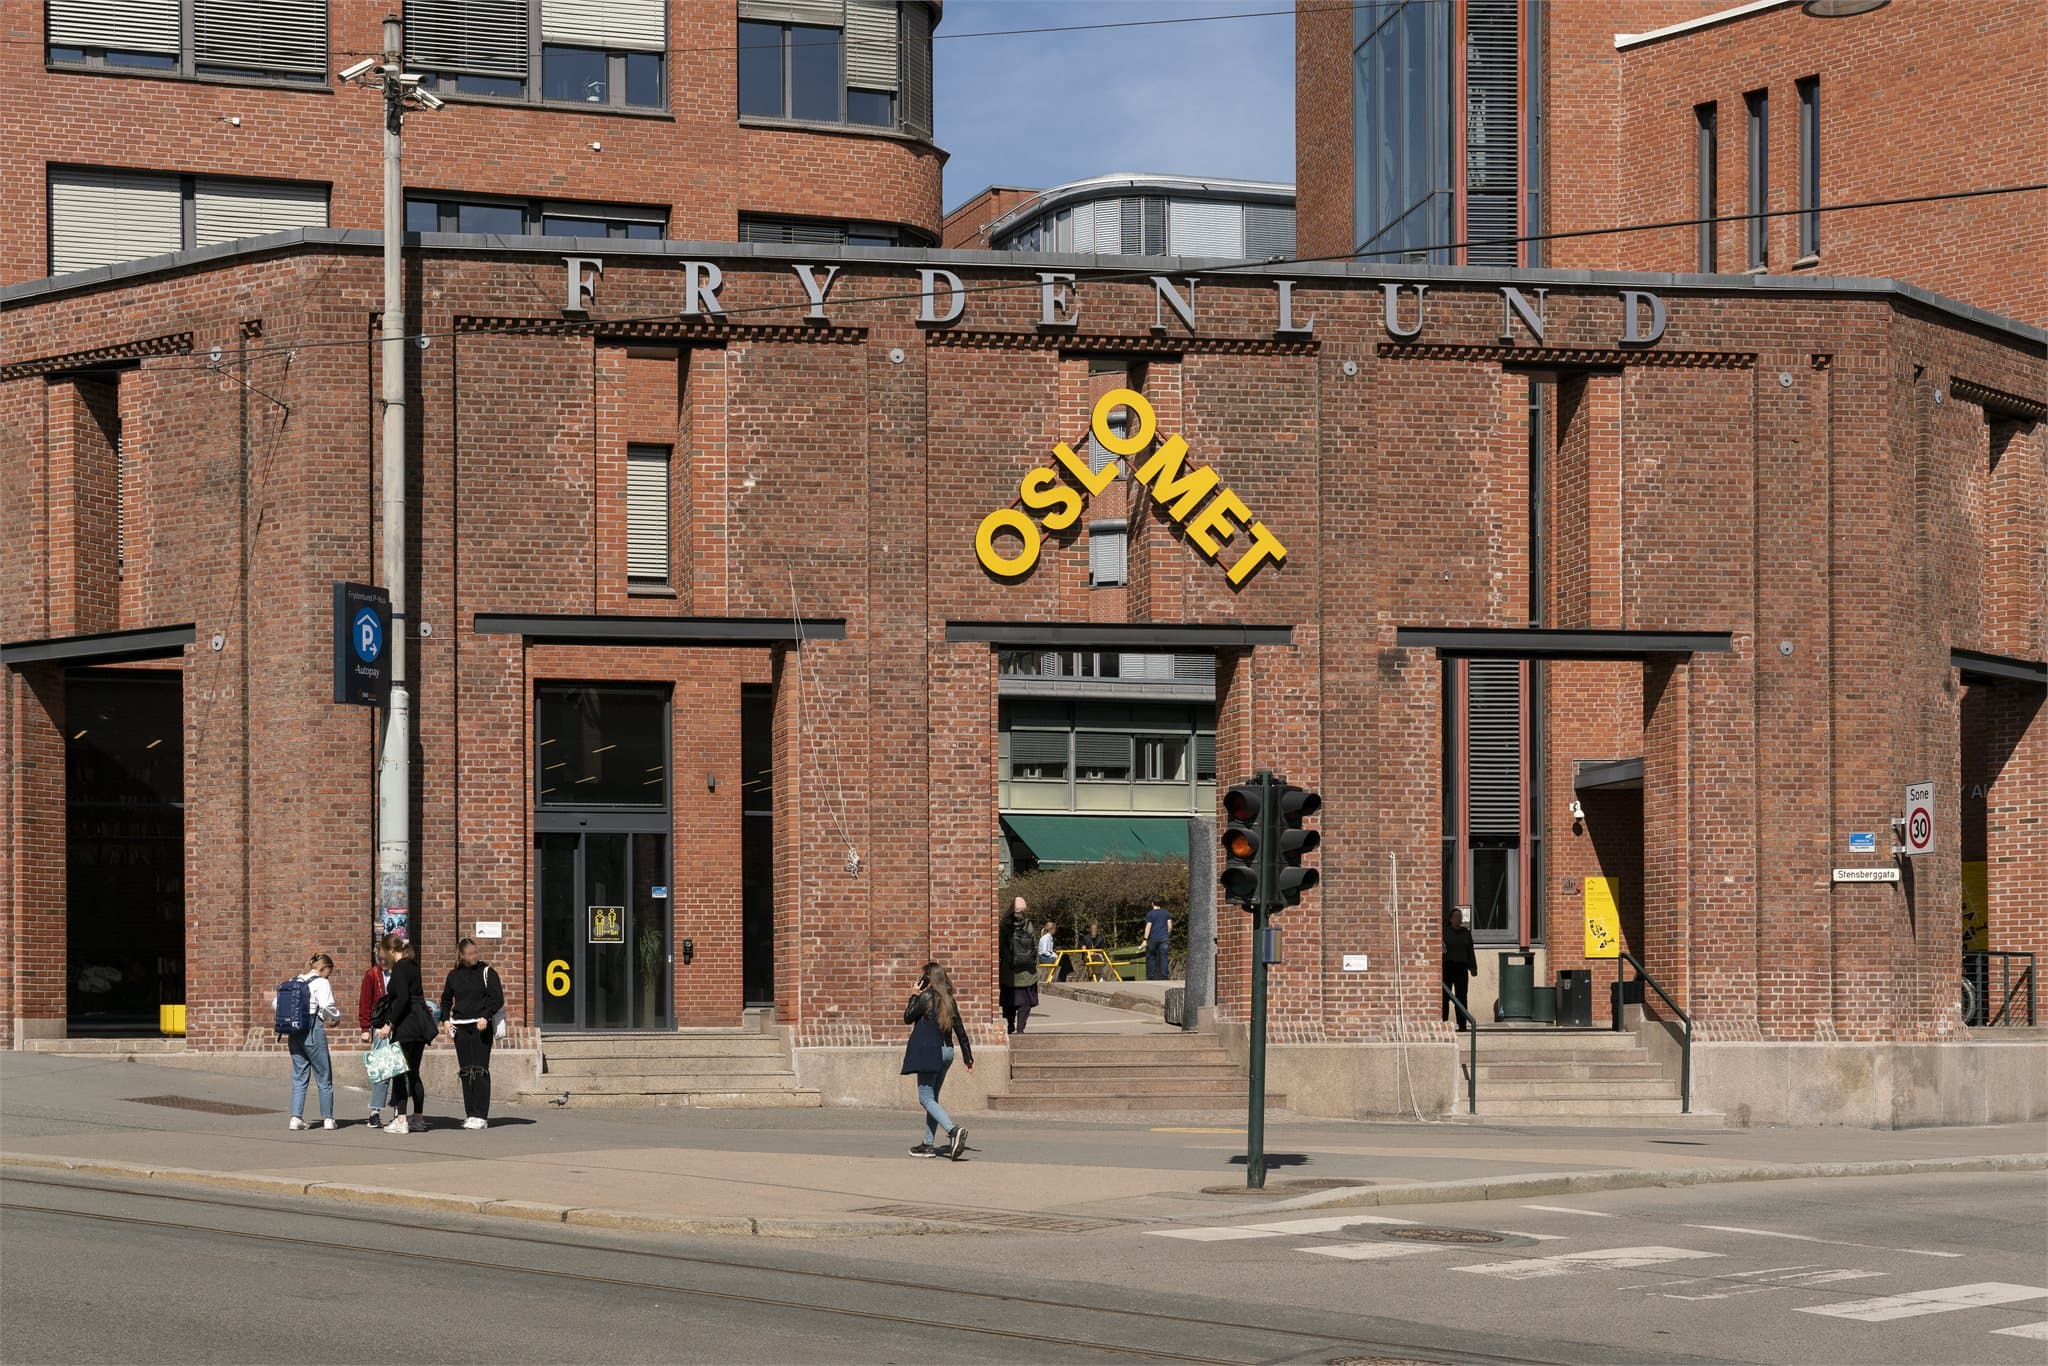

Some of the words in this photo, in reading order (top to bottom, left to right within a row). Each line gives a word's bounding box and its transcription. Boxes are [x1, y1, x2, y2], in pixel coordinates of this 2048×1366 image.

[562, 256, 1668, 345] FRYDENLUND
[974, 387, 1288, 586] OSLOMET
[1910, 788, 1929, 801] Sone
[1913, 818, 1927, 839] 30
[1837, 869, 1895, 881] Stensberggata
[545, 959, 571, 997] 6
